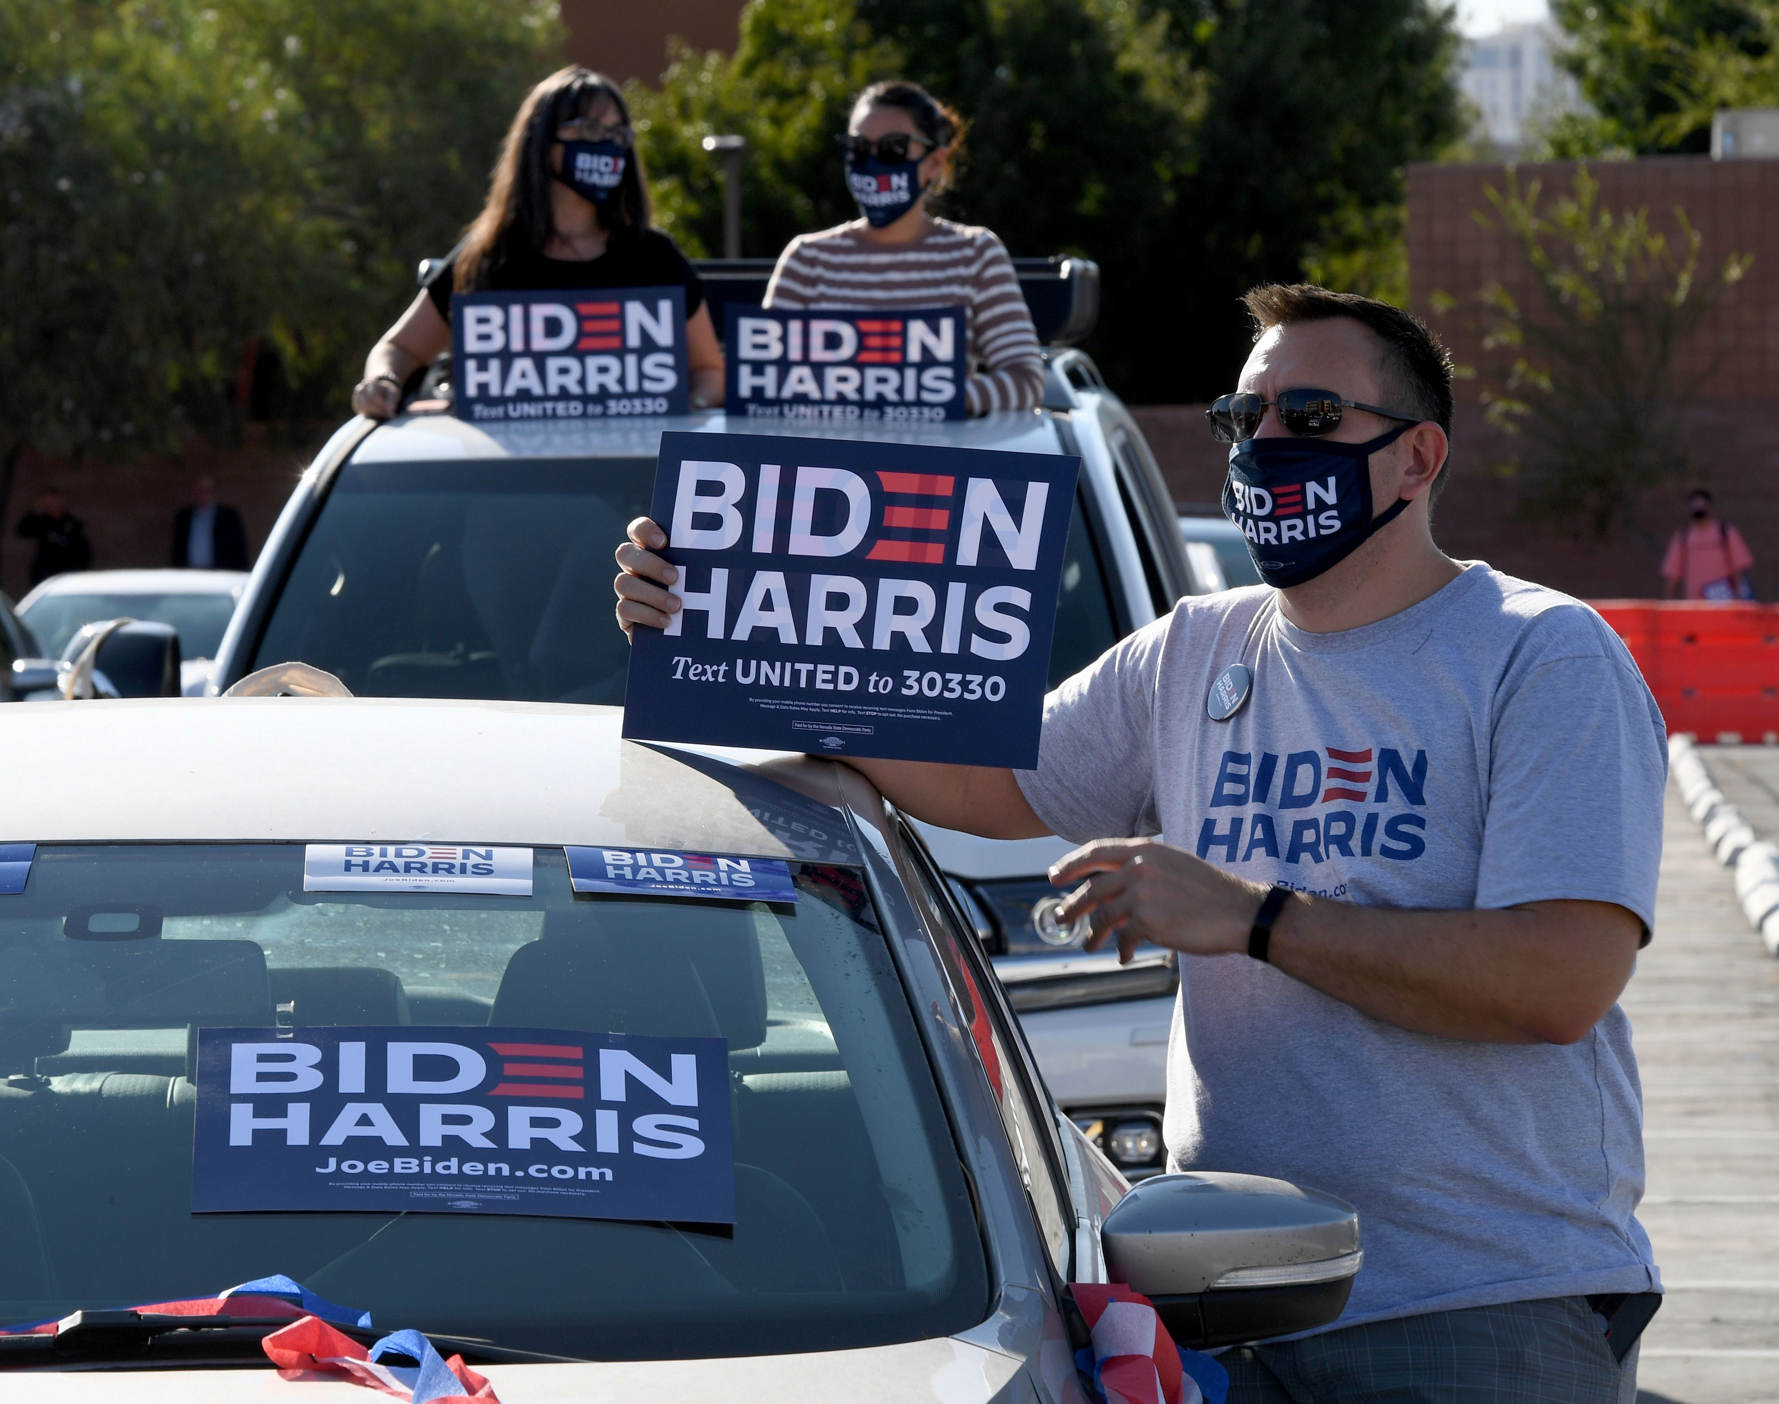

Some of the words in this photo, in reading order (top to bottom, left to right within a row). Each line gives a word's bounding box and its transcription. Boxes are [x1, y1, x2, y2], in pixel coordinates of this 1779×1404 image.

[462, 299, 674, 353] BIDEN
[737, 317, 954, 363] BIDEN
[464, 353, 678, 398] HARRIS
[738, 366, 956, 402] HARRIS
[507, 401, 583, 418] UNITED
[606, 398, 669, 415] 30330
[783, 404, 860, 419] UNITED
[883, 406, 946, 421] 30330
[669, 460, 1049, 570] BIDEN
[1232, 475, 1338, 516] BIDEN
[663, 565, 1032, 661] HARRIS
[671, 656, 728, 683] Text
[735, 659, 859, 691] UNITED
[868, 670, 893, 694] to
[900, 670, 1006, 702] 30330
[1210, 747, 1428, 809] BIDEN
[345, 846, 494, 861] BIDEN
[1196, 811, 1426, 864] HARRIS
[343, 860, 495, 876] HARRIS
[602, 850, 751, 873] BIDEN
[605, 865, 756, 887] HARRIS
[229, 1041, 700, 1107] BIDEN
[229, 1102, 706, 1160] HARRIS
[315, 1157, 614, 1181] JoeBiden.com
